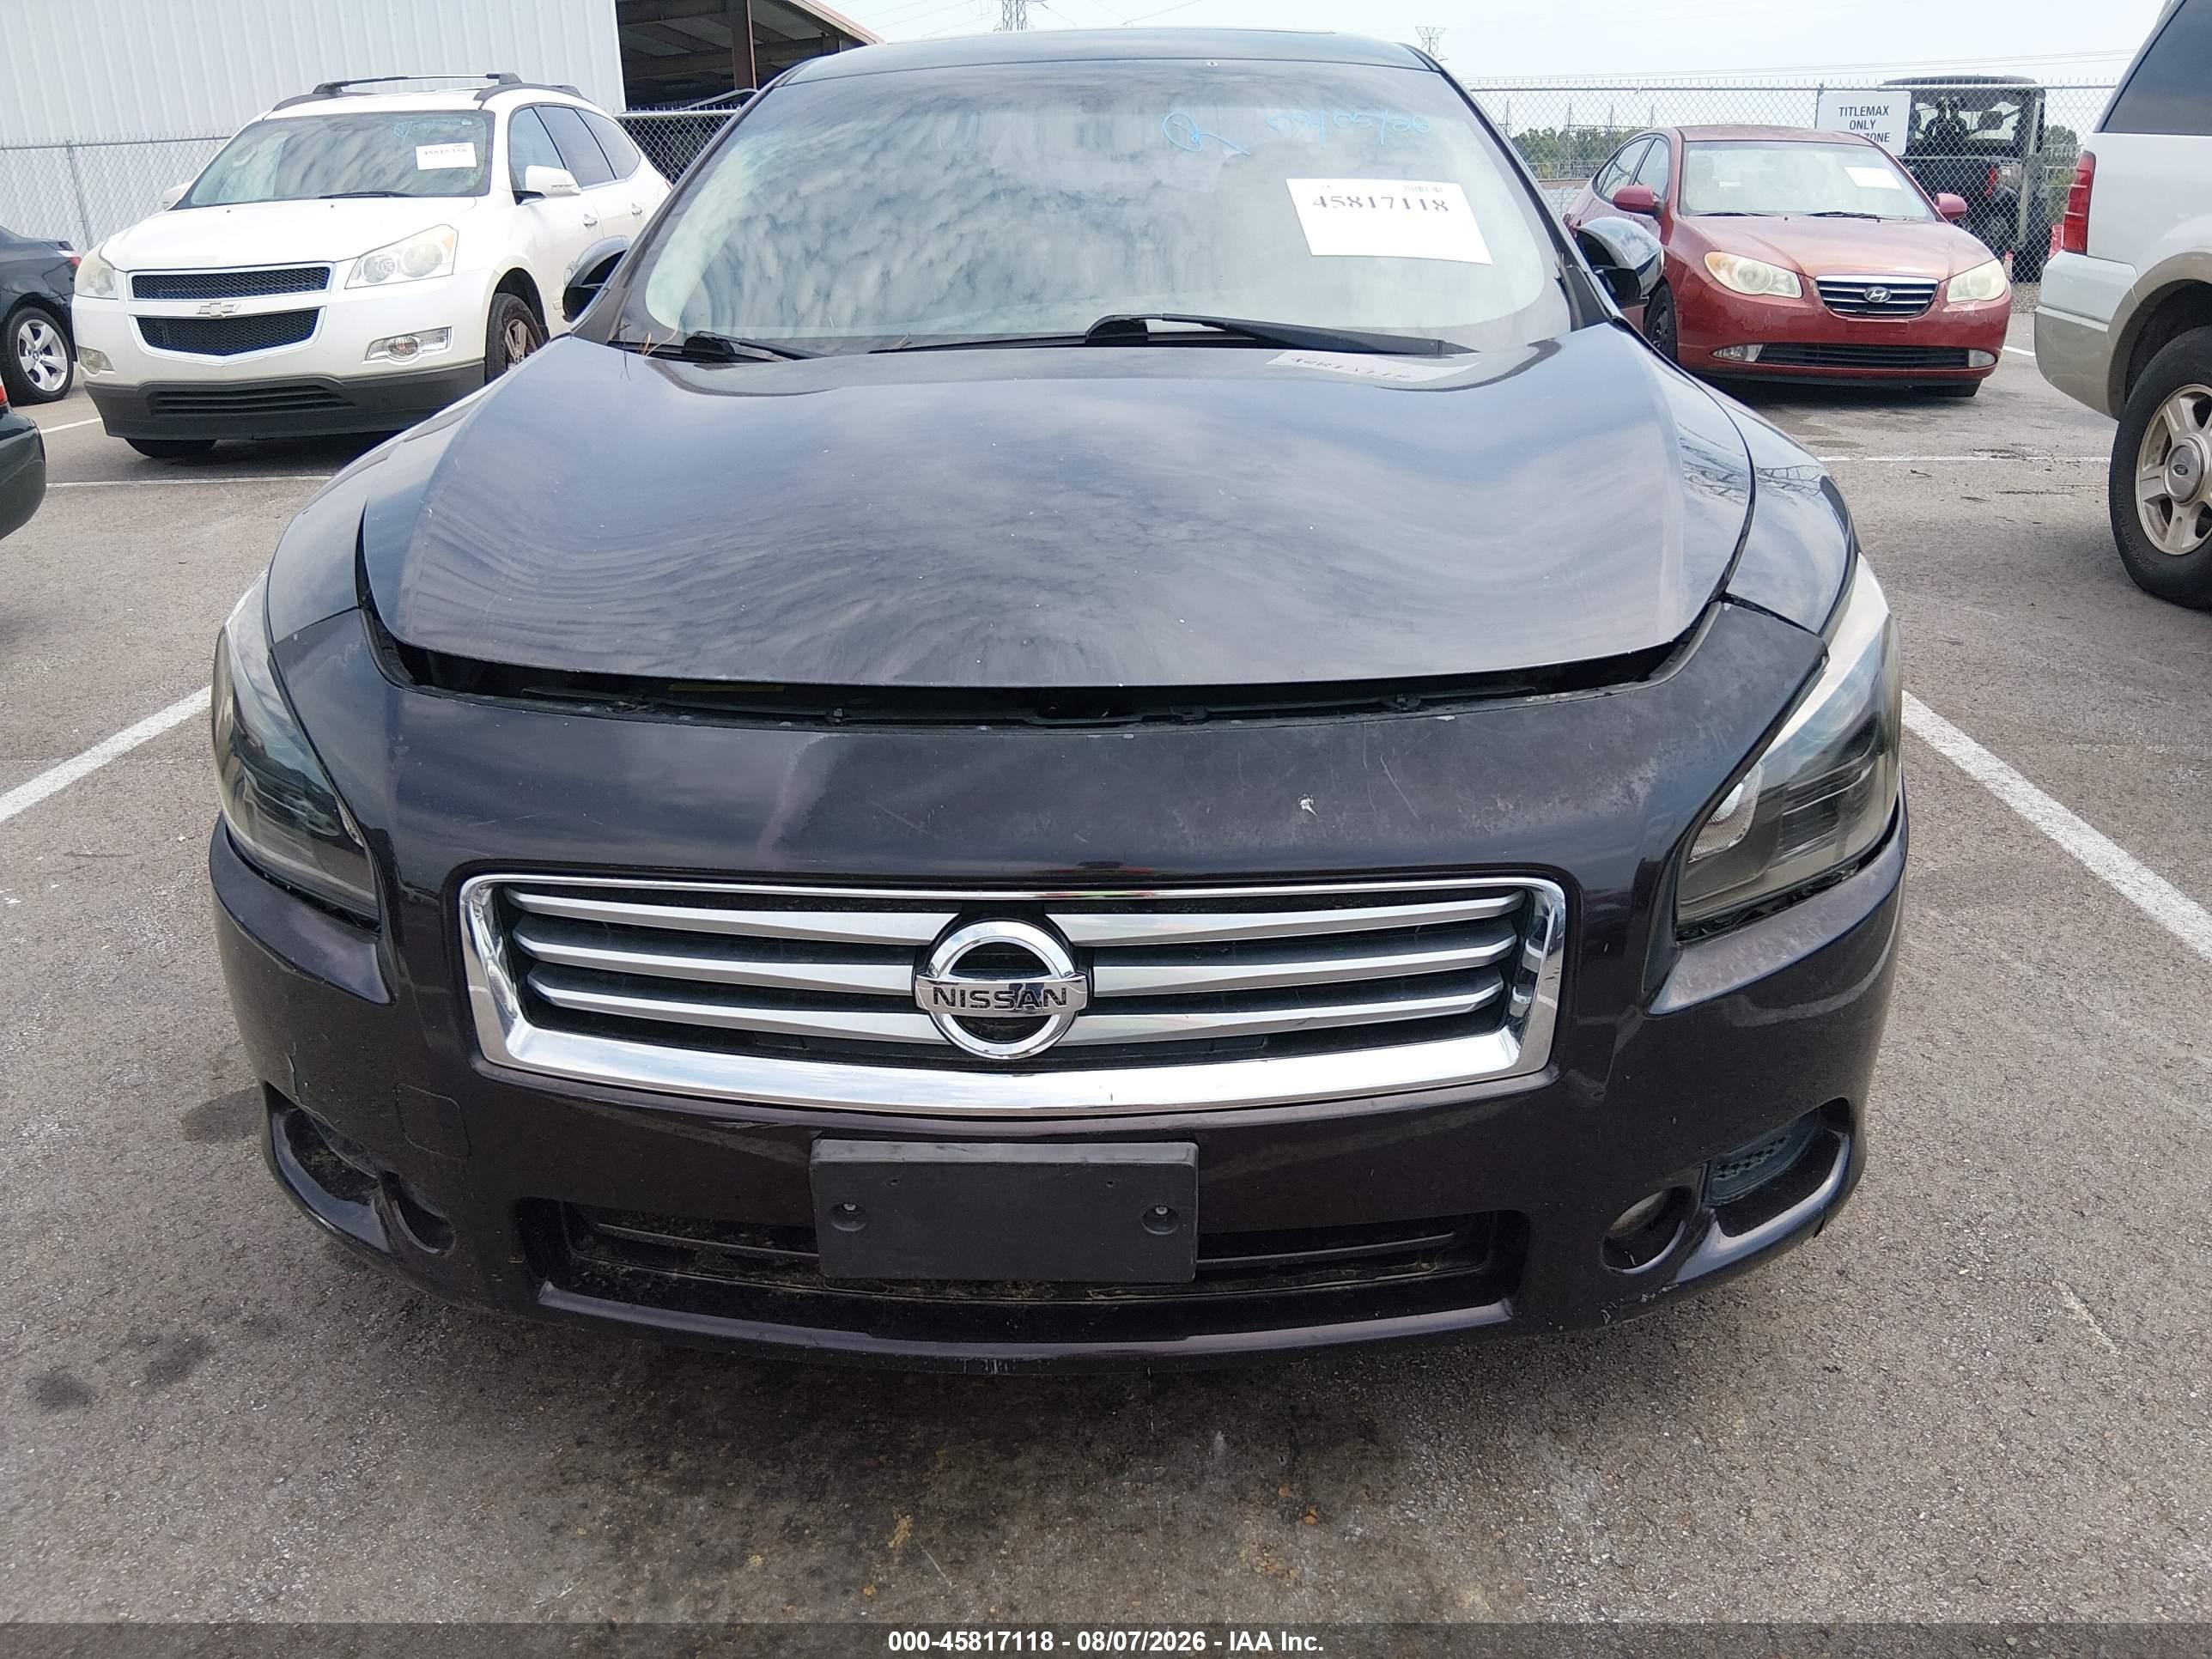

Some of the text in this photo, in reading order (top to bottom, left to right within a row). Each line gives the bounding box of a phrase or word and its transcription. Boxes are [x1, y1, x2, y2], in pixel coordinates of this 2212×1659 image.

[1838, 106, 1889, 117] TITLEMAX
[1849, 119, 1876, 130] ONLY
[1313, 196, 1449, 212] 45817118
[933, 987, 1066, 1009] NISSAN
